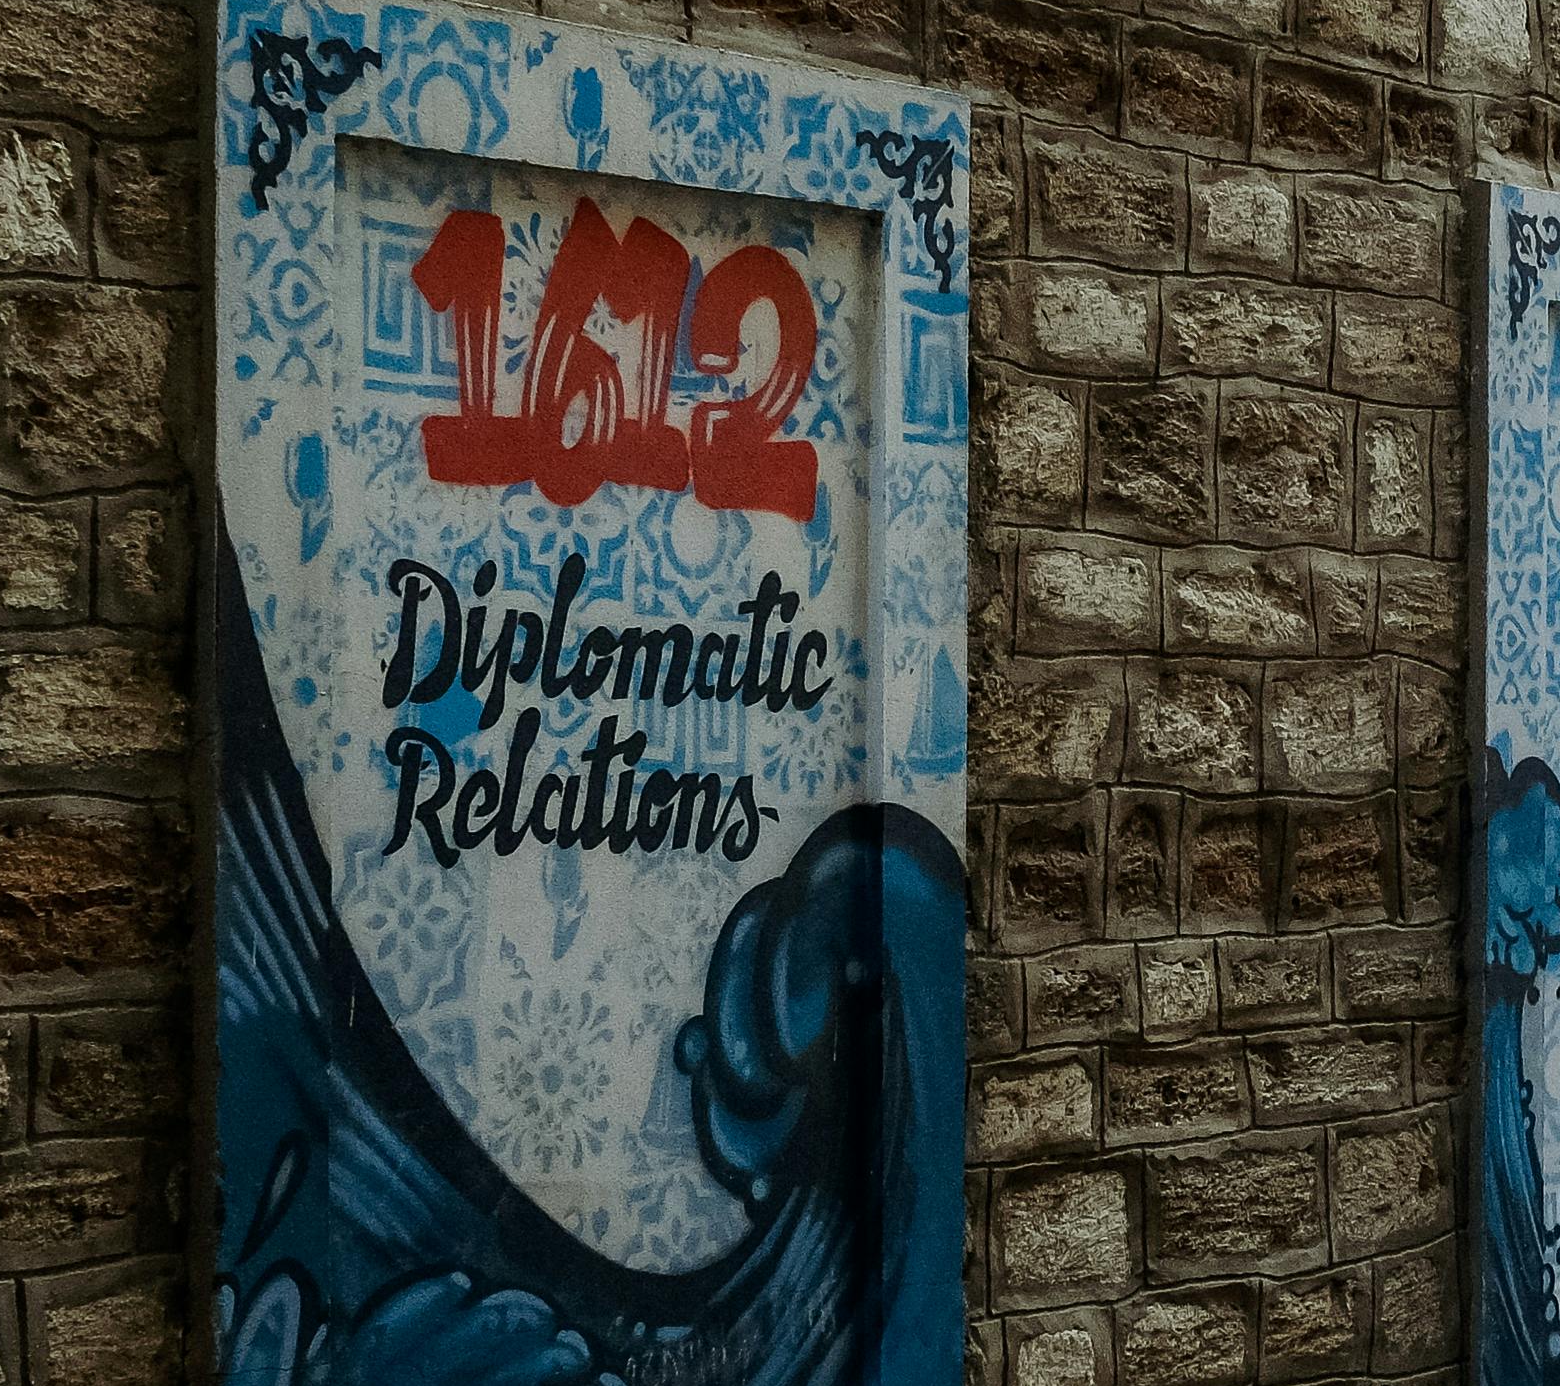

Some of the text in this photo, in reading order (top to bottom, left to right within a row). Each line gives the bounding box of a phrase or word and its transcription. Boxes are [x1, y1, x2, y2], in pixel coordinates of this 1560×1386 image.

[411, 196, 820, 524] 1612
[381, 552, 833, 730] Diplomatic
[382, 707, 779, 869] Relations
